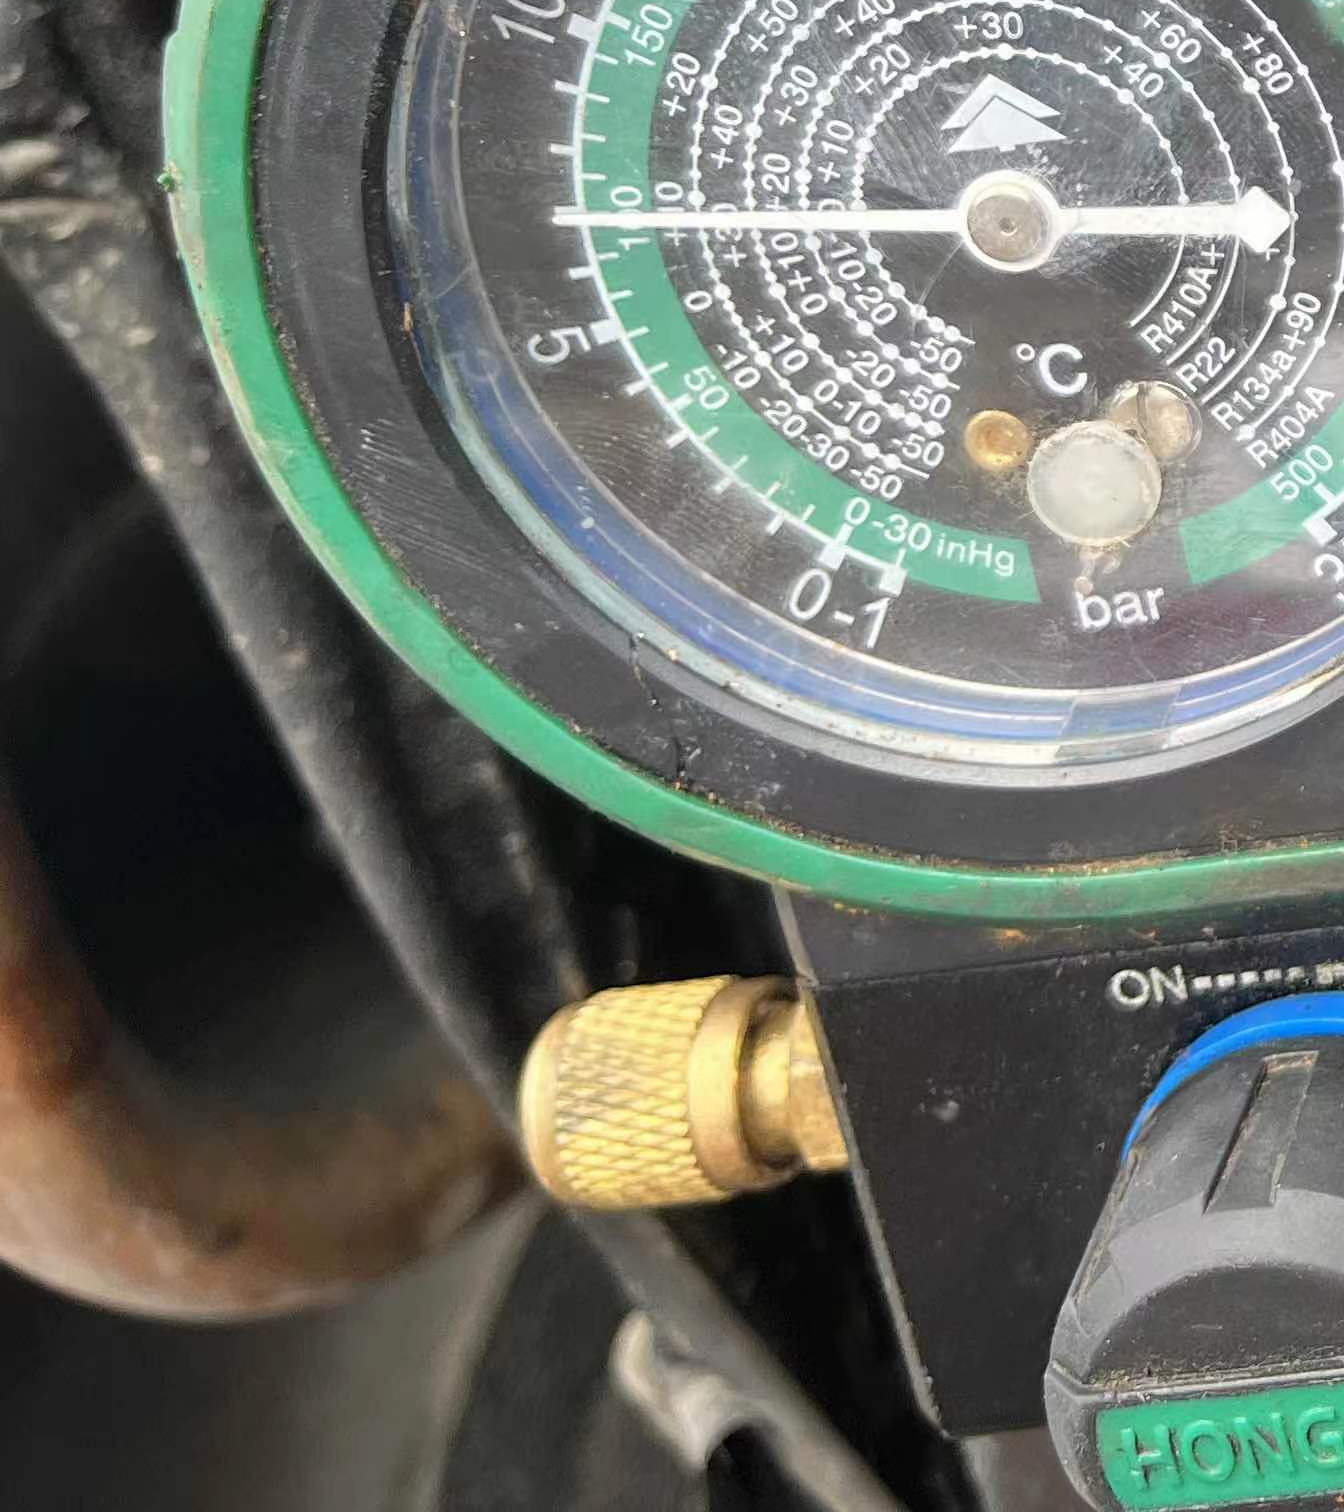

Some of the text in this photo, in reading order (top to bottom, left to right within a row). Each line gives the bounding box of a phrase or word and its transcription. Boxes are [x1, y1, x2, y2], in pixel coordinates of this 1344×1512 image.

[625, 4, 673, 66] 150
[954, 12, 1024, 40] +30
[1141, 9, 1202, 64] +60
[662, 52, 701, 117] +20
[855, 43, 911, 95] +20
[1103, 45, 1164, 98] +40
[1241, 32, 1294, 95] +80
[774, 65, 818, 126] +30
[711, 105, 743, 169] +40
[818, 120, 854, 184] +10
[611, 186, 650, 250] 10
[771, 232, 813, 292] +10
[684, 291, 712, 313] 0
[853, 283, 897, 326] -20
[527, 326, 592, 366] 5
[716, 344, 761, 390] -10
[755, 315, 809, 373] +10
[846, 350, 896, 388] -20
[911, 339, 962, 373] -50
[1016, 342, 1088, 398] °C
[1176, 336, 1236, 392] R22
[684, 366, 729, 410] 50
[899, 388, 951, 419] -50
[893, 438, 944, 468] -50
[1247, 387, 1335, 469] R404A
[850, 467, 903, 499] -50
[1269, 444, 1335, 503] 500
[937, 533, 1016, 577] inHg
[1074, 585, 1165, 629] bar
[1109, 964, 1189, 1011] ON
